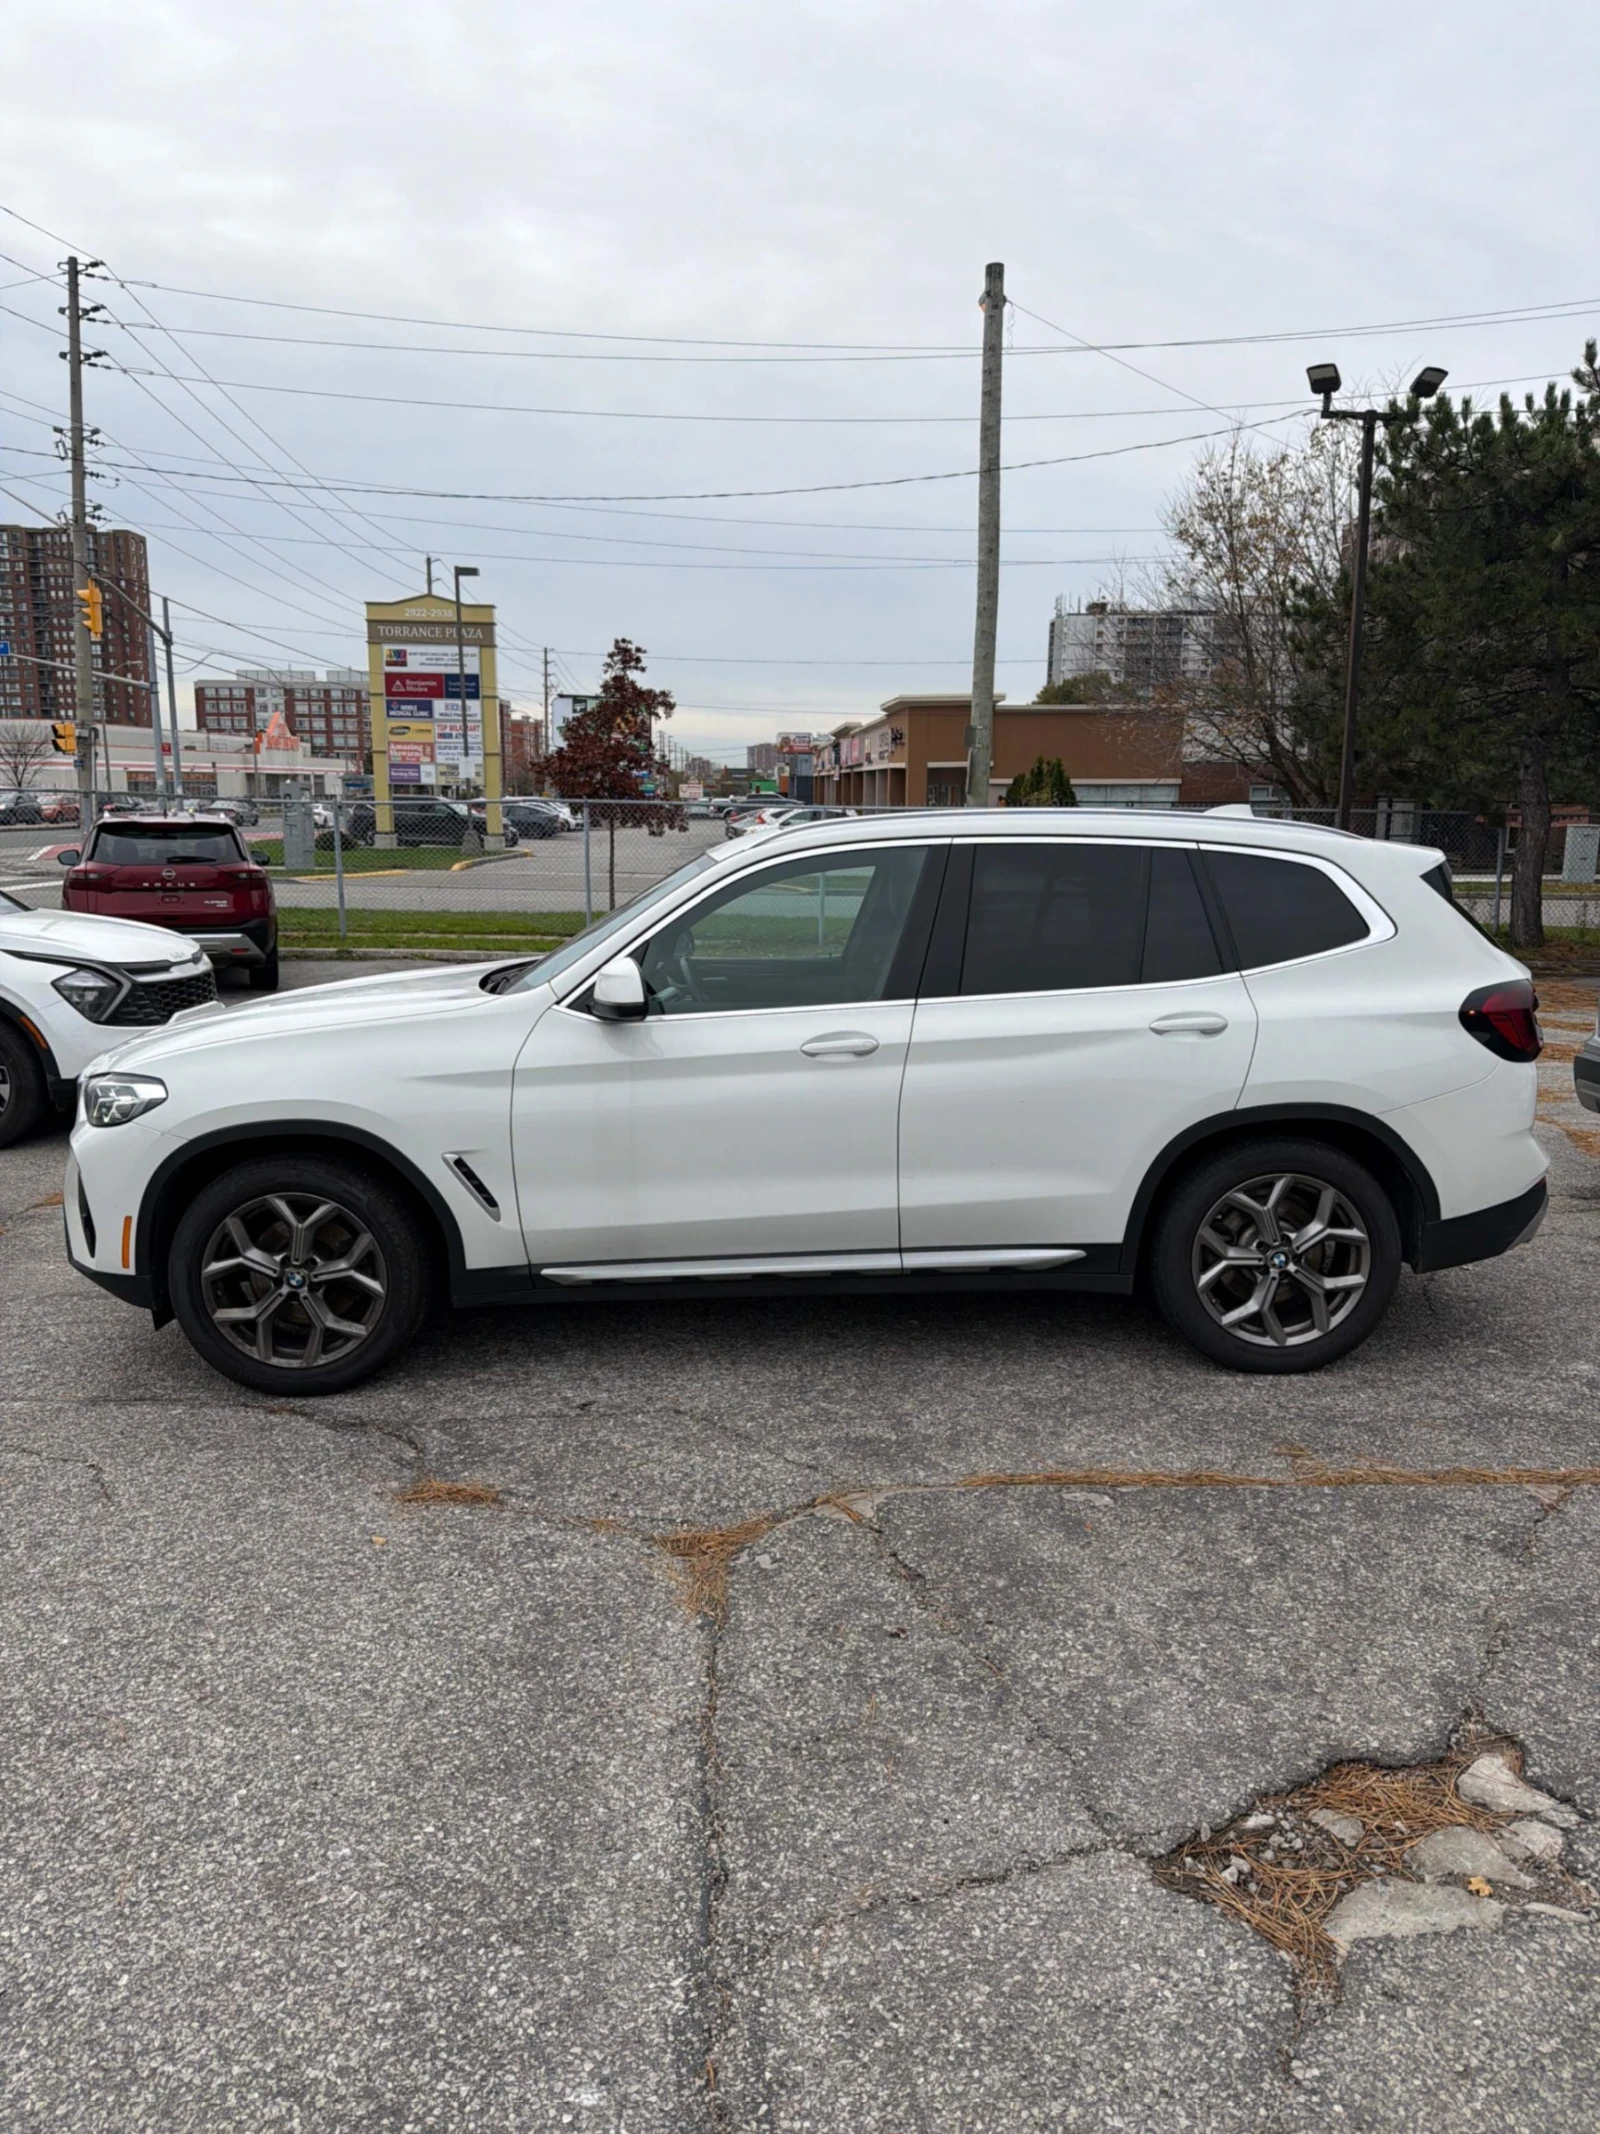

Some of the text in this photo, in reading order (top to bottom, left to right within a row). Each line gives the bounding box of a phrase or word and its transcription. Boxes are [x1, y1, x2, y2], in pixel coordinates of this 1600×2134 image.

[404, 608, 454, 618] 2922-2938
[377, 625, 483, 639] TORRANCE PLAZA
[405, 679, 437, 687] Benjamin
[437, 724, 448, 732] TOP
[390, 743, 424, 751] Amazing
